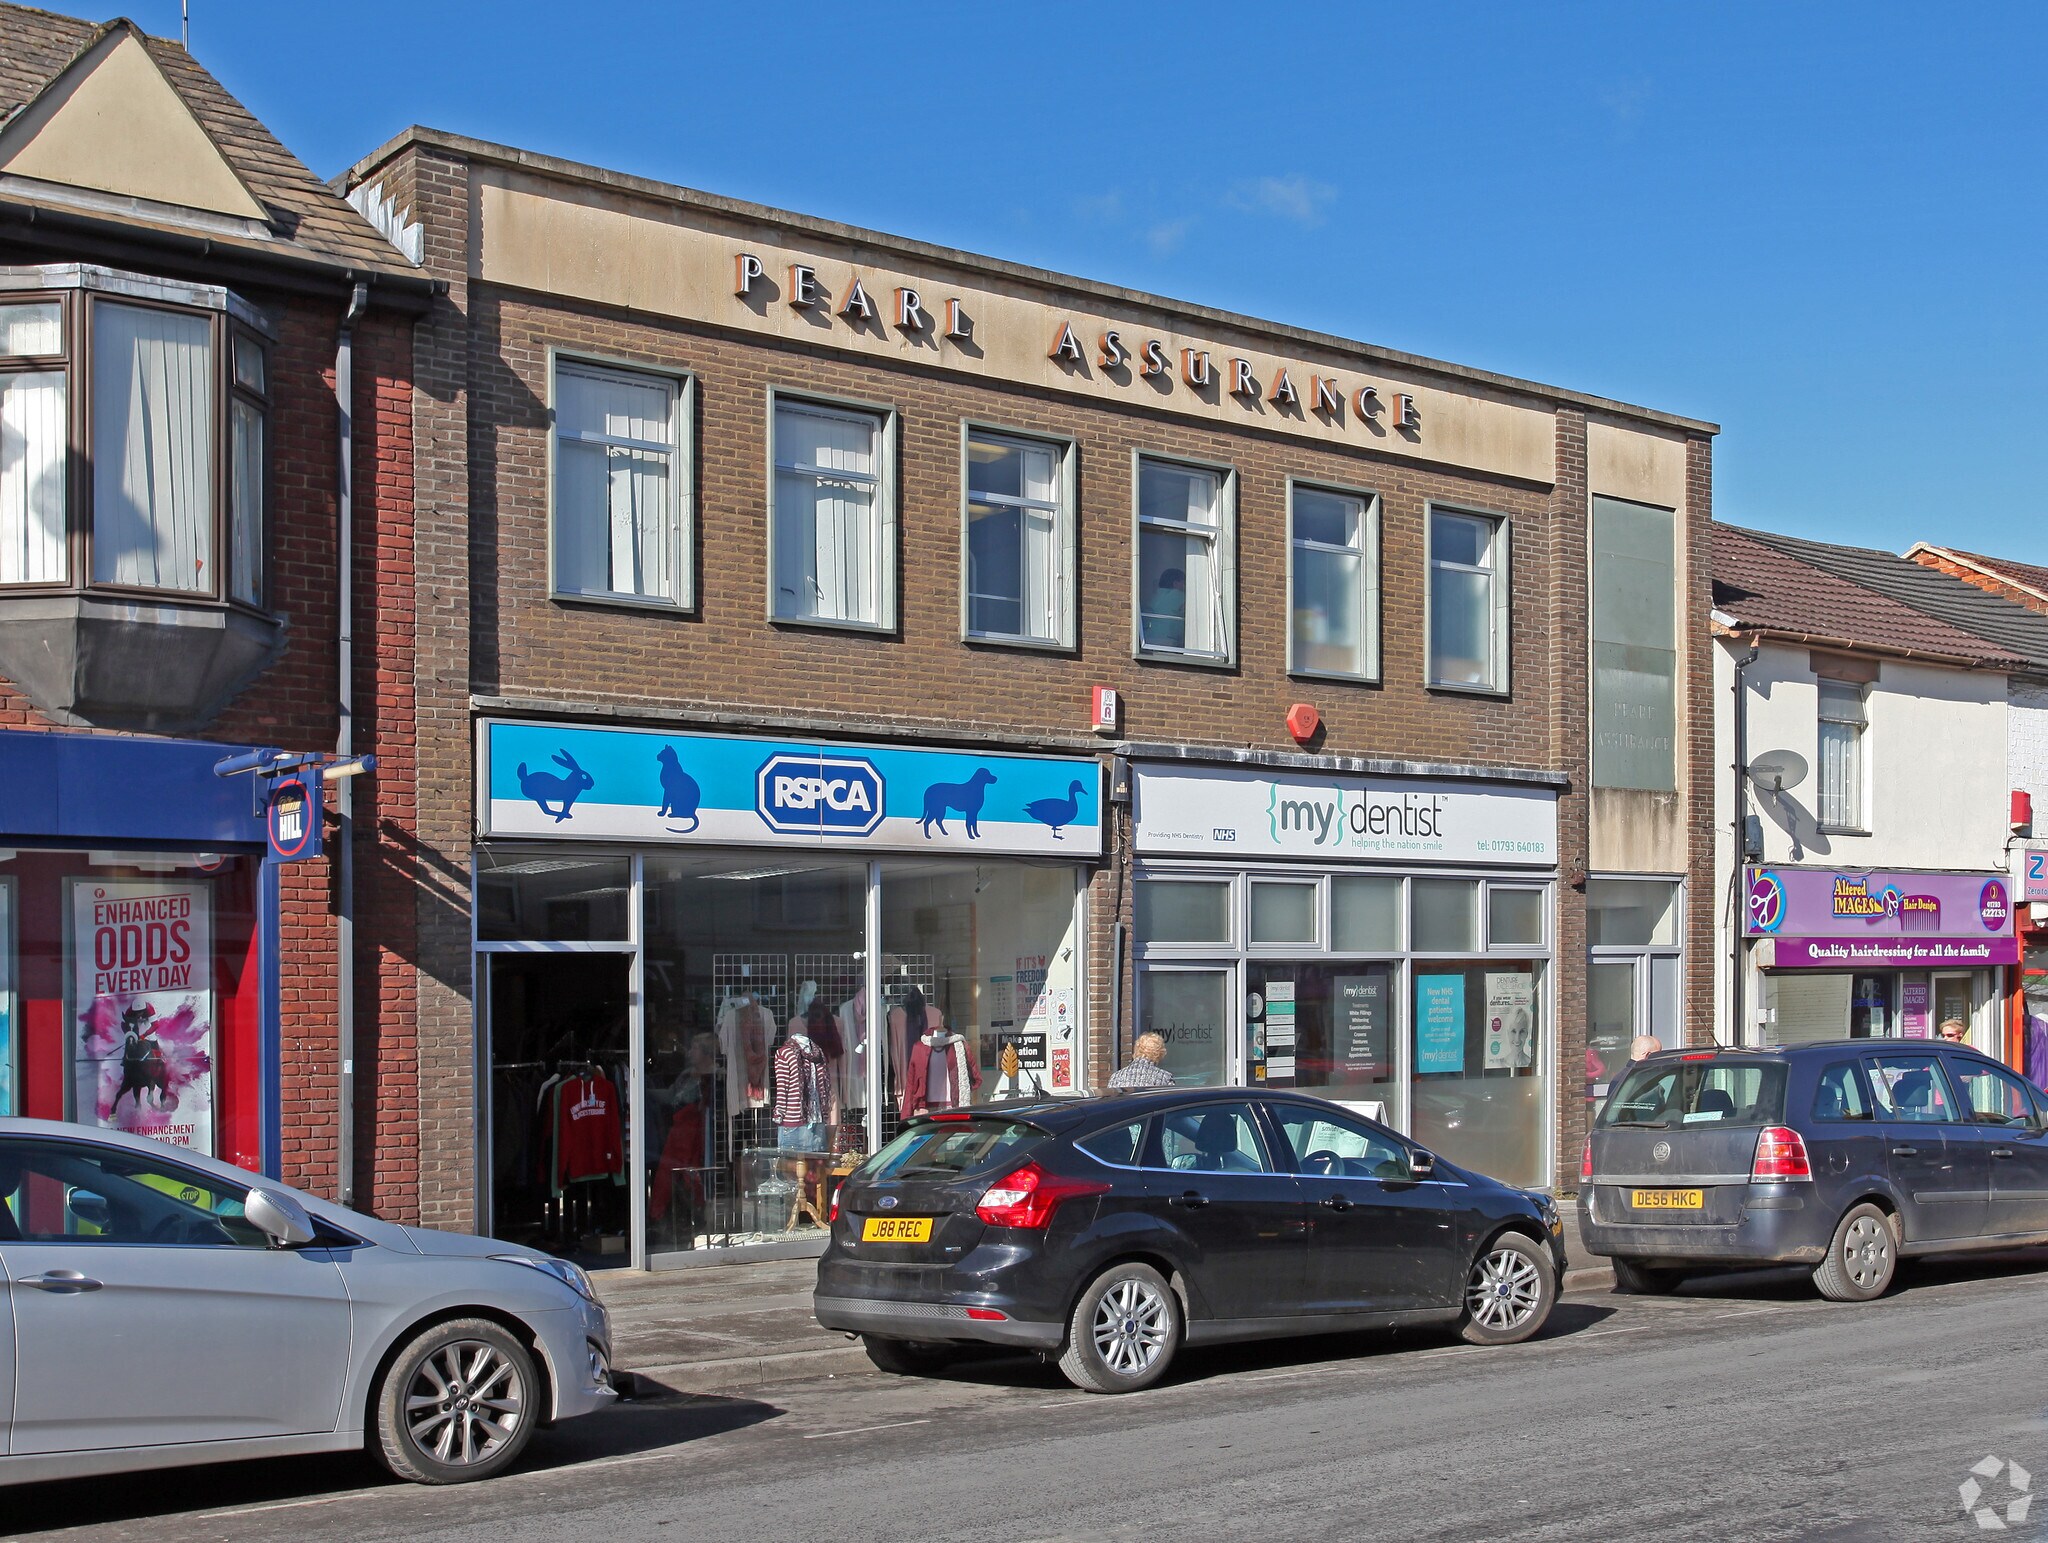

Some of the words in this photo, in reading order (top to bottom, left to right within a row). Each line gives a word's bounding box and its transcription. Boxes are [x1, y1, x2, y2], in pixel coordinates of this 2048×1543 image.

[735, 253, 970, 337] PEARL
[1049, 320, 1414, 428] ASSURANCE
[1614, 702, 1656, 720] PEARL
[1598, 732, 1670, 751] ASSURANCE
[774, 775, 872, 812] RSPCA
[279, 813, 302, 841] HILL
[1147, 831, 1171, 840] Providing
[1182, 832, 1204, 840] Dentistry
[1212, 828, 1236, 841] NHS
[1351, 836, 1381, 850] helping
[1382, 837, 1396, 848] the
[1396, 839, 1421, 850] nation
[1422, 840, 1443, 851] smile
[1477, 840, 1490, 851] tel:
[1491, 840, 1515, 852] 01793
[1516, 841, 1545, 853] 640183
[2029, 855, 2048, 880] Z
[1833, 878, 1867, 897] Altered
[2027, 887, 2040, 895] Zero
[95, 898, 191, 925] ENHANCED
[1833, 895, 1877, 914] IMAGES
[1902, 898, 1917, 911] Hair
[1917, 898, 1937, 912] Design
[1981, 908, 2006, 917] 422733
[95, 920, 191, 971] ODDS
[1808, 943, 1849, 959] Quality
[1850, 944, 1913, 959] hairdressing
[1913, 944, 1928, 957] for
[1929, 944, 1943, 957] all
[1943, 944, 1959, 957] the
[1960, 944, 1991, 958] family
[1016, 958, 1023, 971] IF
[1024, 956, 1037, 969] IT'S
[95, 968, 153, 995] EVERY
[158, 964, 192, 988] DAY
[1016, 969, 1046, 983] FREEDOM
[1496, 976, 1519, 984] DENTURE
[1029, 983, 1046, 995] FOOD
[1427, 988, 1441, 996] New
[1441, 987, 1454, 996] NHS
[1903, 987, 1926, 995] ALTERED
[1431, 997, 1450, 1005] dental
[1428, 1006, 1453, 1015] patients
[1428, 1015, 1454, 1023] welcome
[1001, 1035, 1022, 1043] Make
[1023, 1036, 1041, 1045] your
[136, 1124, 195, 1136] ENHANCEMENT
[172, 1136, 190, 1146] 3PM
[181, 1190, 199, 1201] STOP
[1637, 1192, 1668, 1206] DE56
[1671, 1192, 1697, 1206] HKC
[871, 1220, 896, 1238] J88
[896, 1220, 922, 1238] REC
